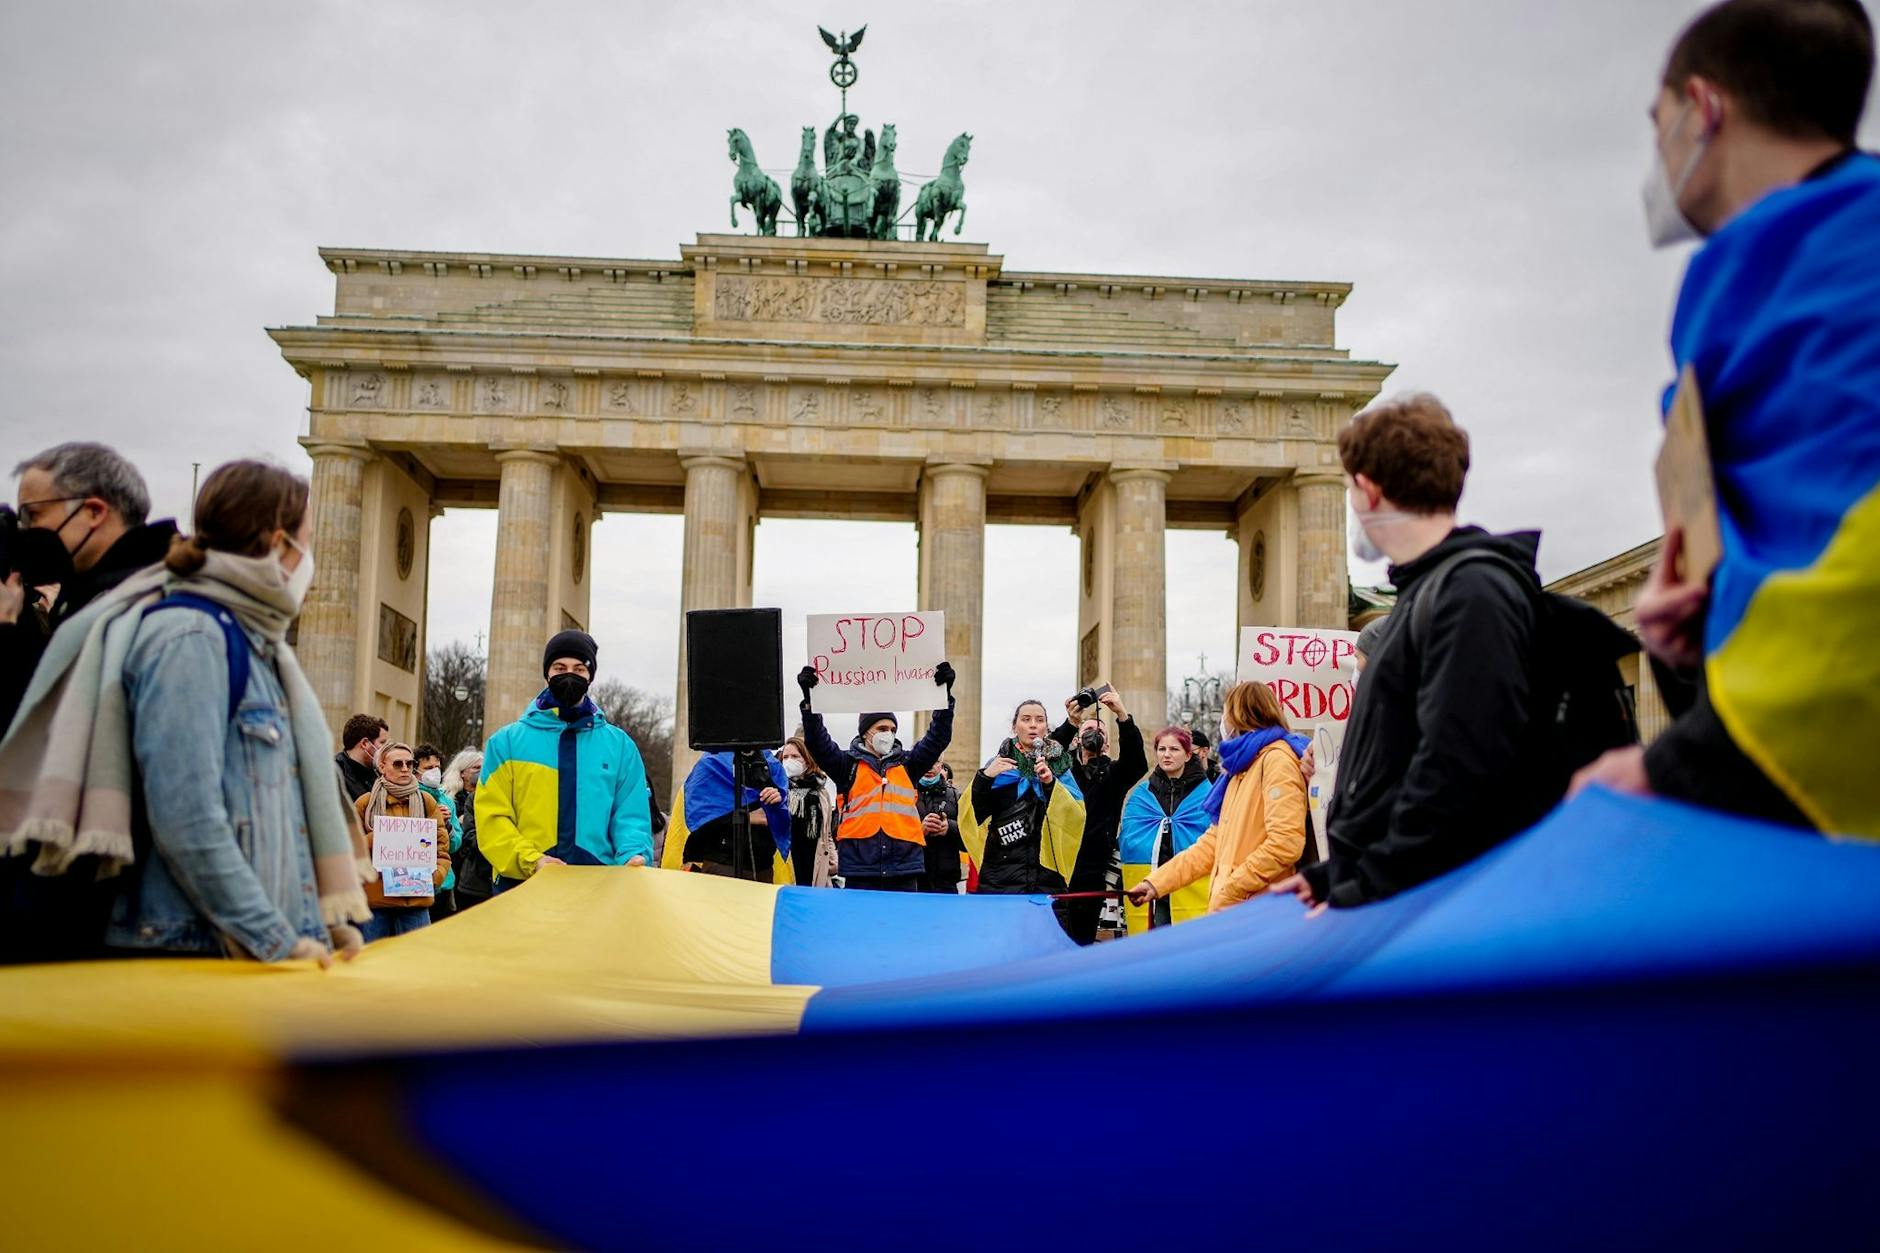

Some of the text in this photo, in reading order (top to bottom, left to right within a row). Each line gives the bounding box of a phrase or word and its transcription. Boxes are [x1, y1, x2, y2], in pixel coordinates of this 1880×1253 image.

[831, 615, 925, 653] STOP
[1253, 632, 1355, 671] STOP
[813, 655, 935, 686] Russian Invasio
[379, 818, 433, 833] МИРУ МИР
[998, 820, 1022, 836] ПТН
[380, 845, 404, 861] Kein
